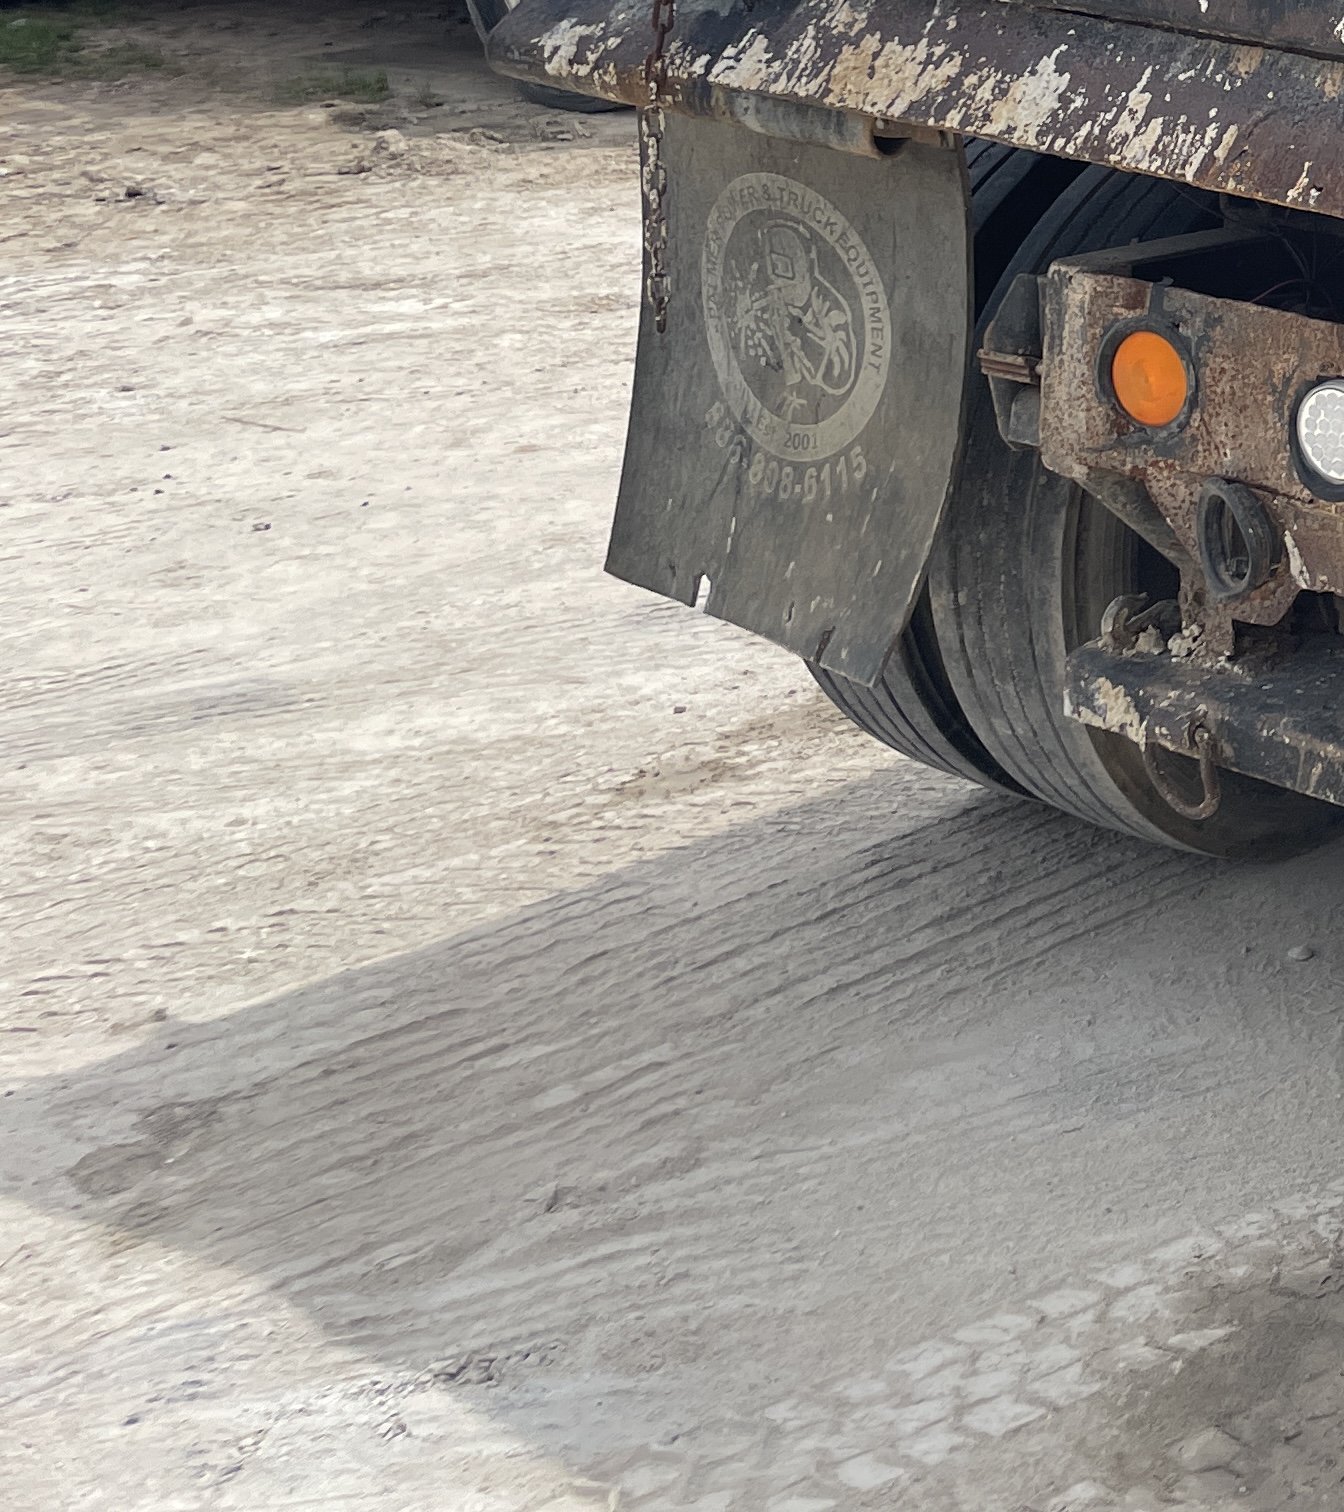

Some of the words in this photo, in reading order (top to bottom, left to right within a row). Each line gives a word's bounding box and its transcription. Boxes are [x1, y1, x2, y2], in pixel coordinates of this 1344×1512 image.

[776, 185, 840, 236] TRUCK
[835, 231, 885, 375] EQUIPMENT
[783, 431, 819, 451] 2001
